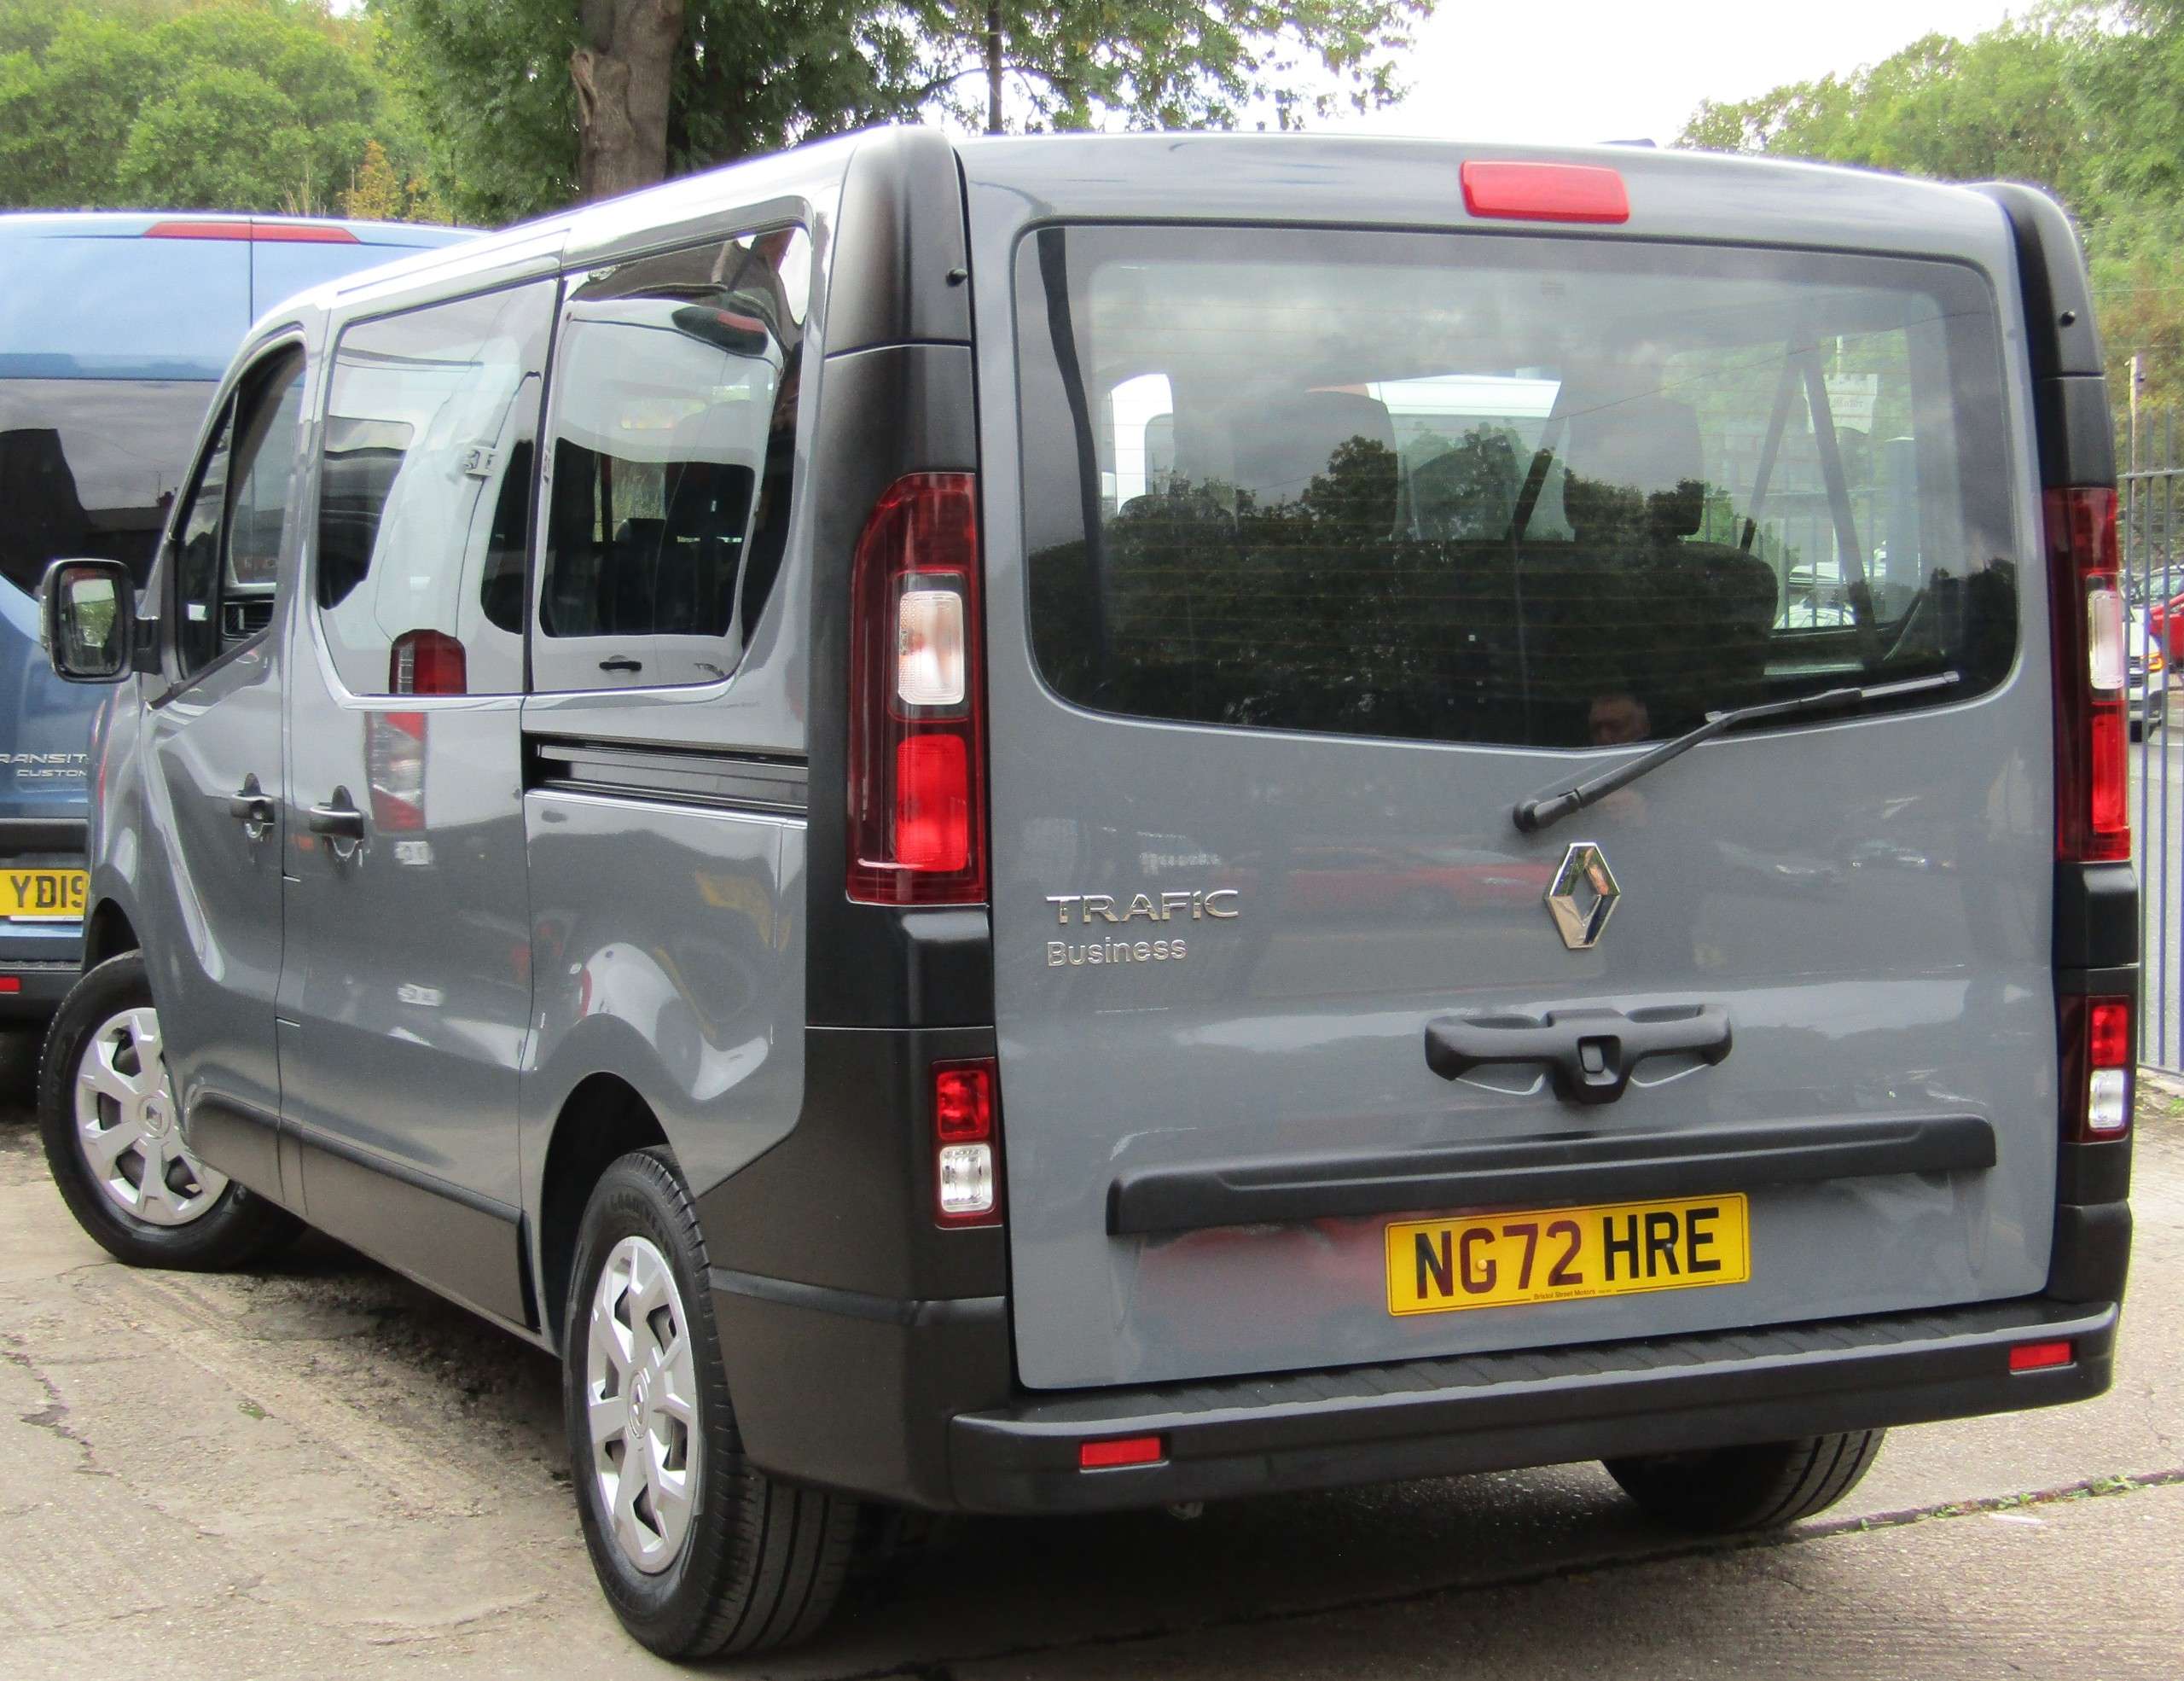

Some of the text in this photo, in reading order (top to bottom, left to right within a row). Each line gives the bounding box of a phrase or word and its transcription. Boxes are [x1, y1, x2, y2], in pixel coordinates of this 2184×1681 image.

[0, 753, 87, 764] RANSIT
[1047, 936, 1188, 967] Business
[1414, 1207, 1722, 1299] NG72 HRE
[1534, 1292, 1554, 1300] Bristol
